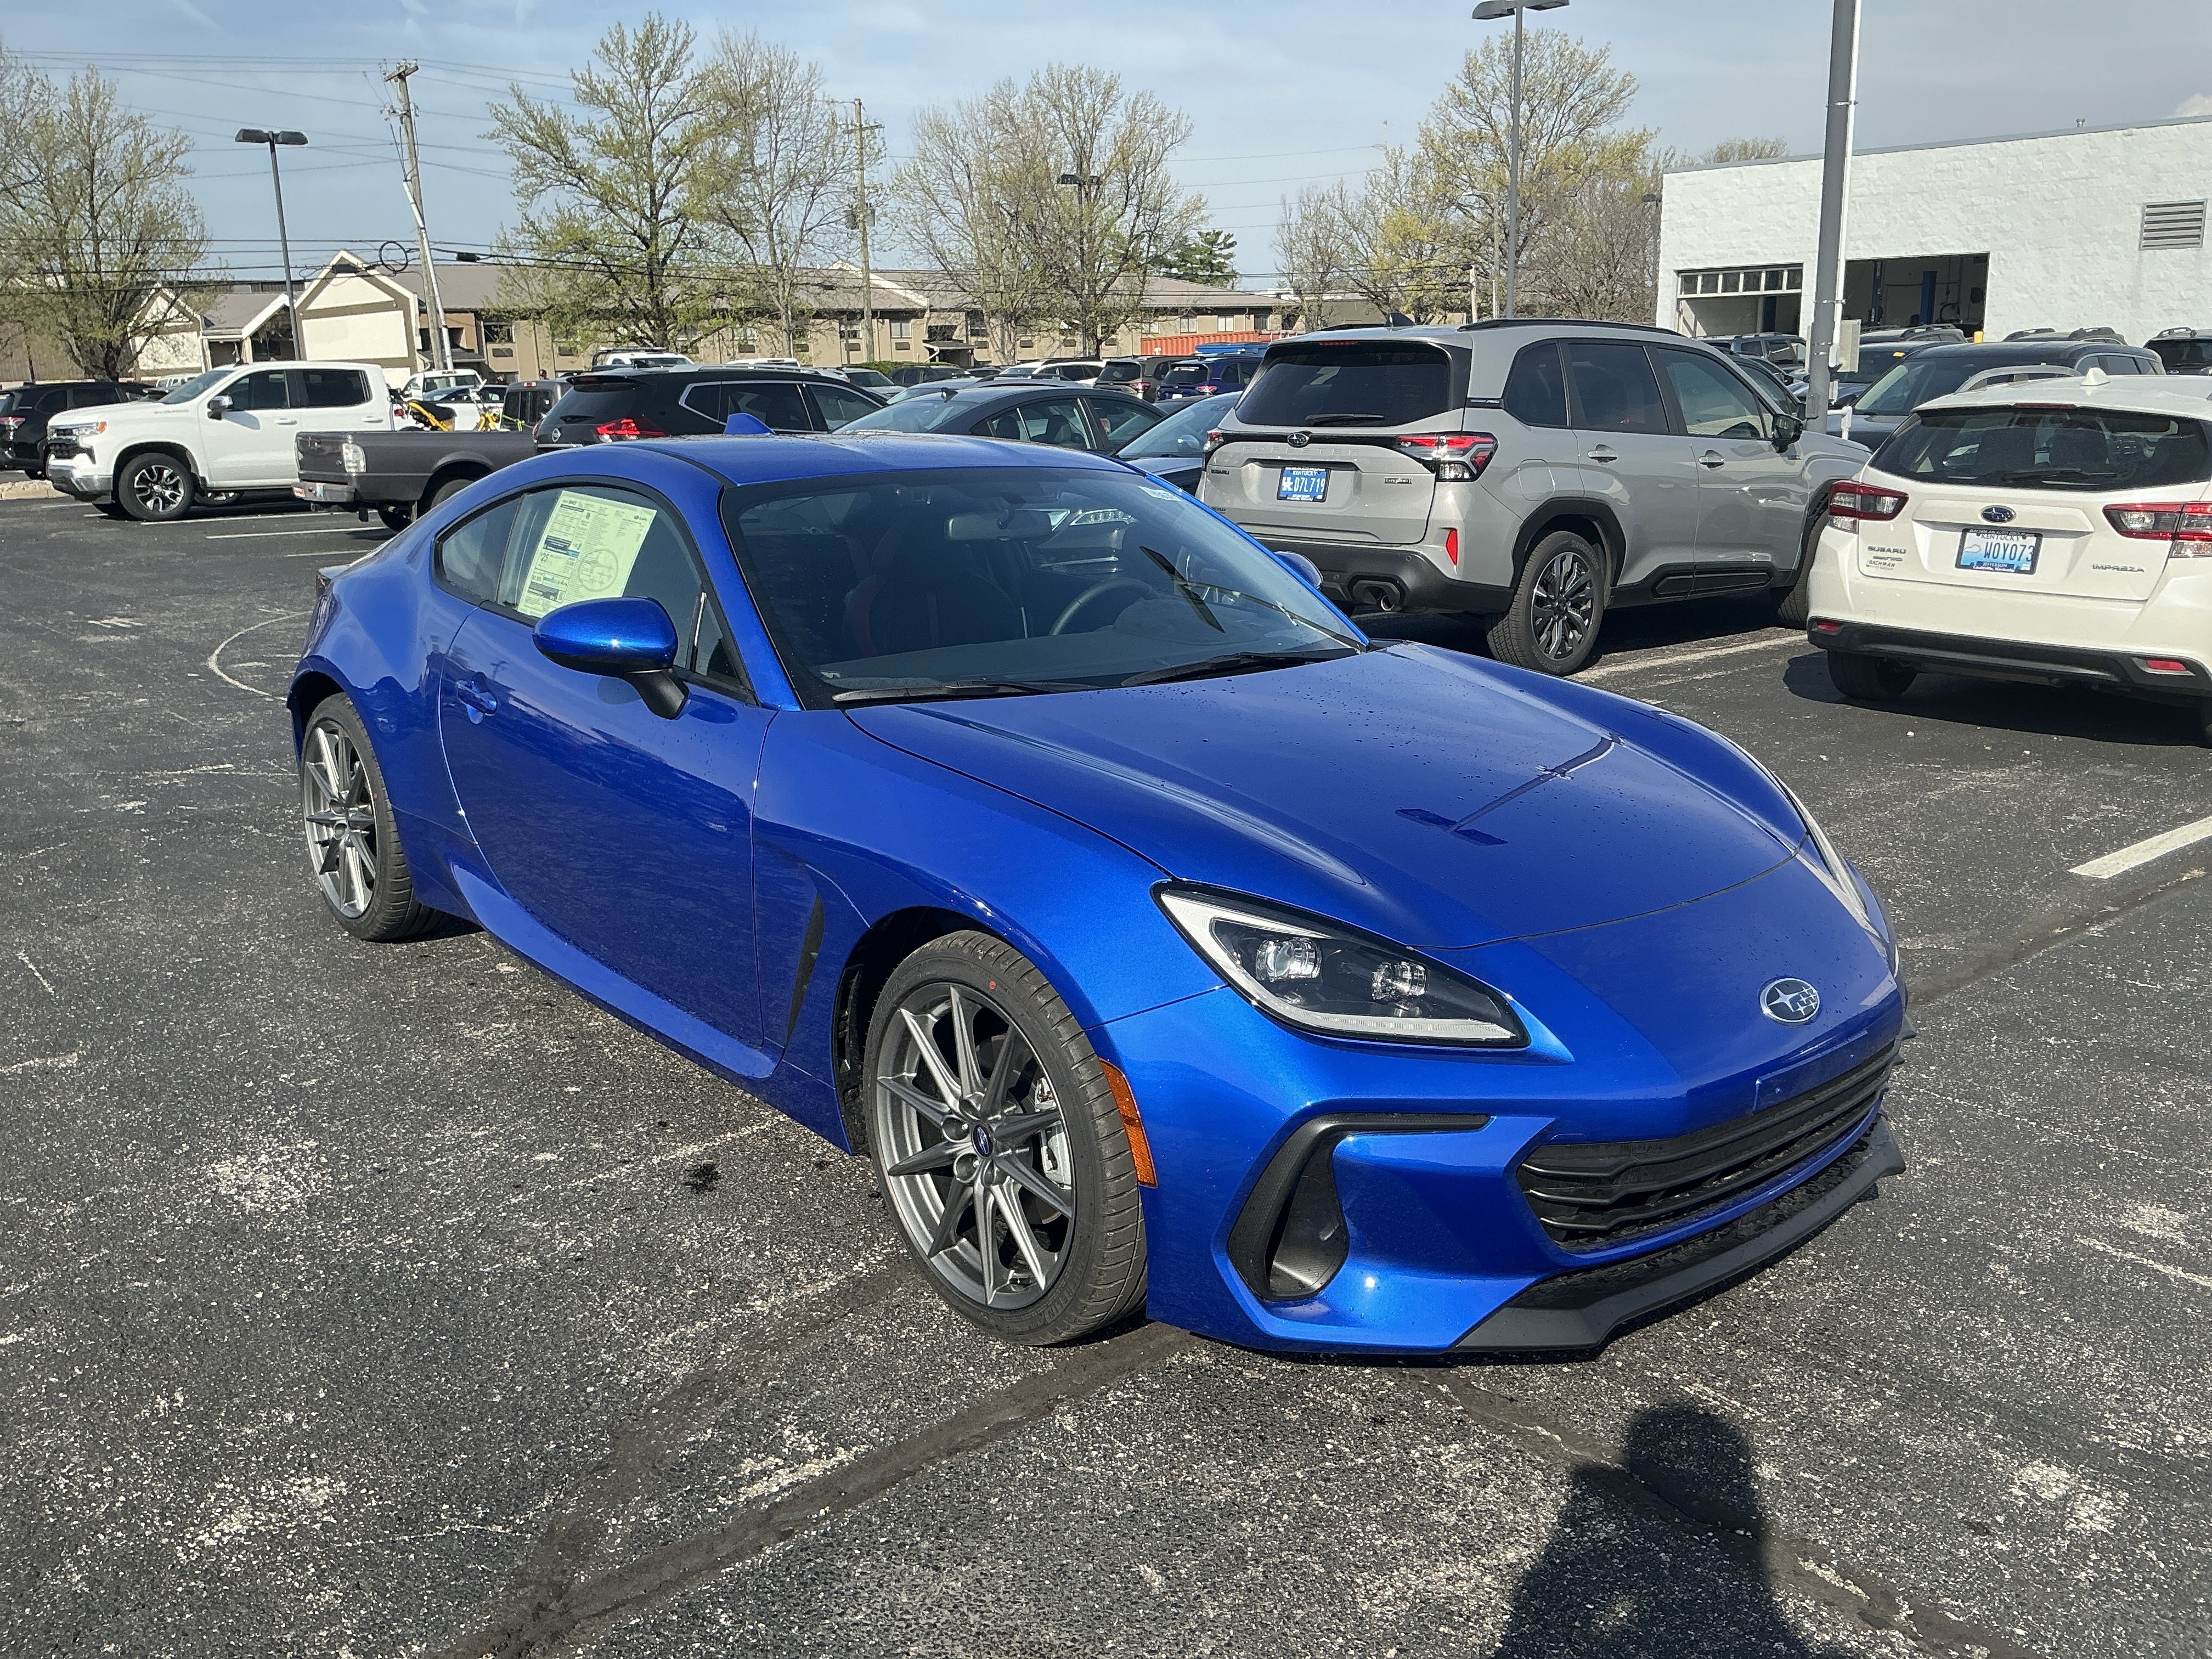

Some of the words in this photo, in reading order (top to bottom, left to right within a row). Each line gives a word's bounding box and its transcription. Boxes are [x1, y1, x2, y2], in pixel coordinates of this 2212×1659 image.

[1243, 445, 1360, 456] FORESTER
[1294, 477, 1326, 493] D7L719
[1571, 540, 1599, 571] BRIDGESTONE
[1867, 546, 1906, 554] SUBARU
[2092, 563, 2145, 572] IMPREZA
